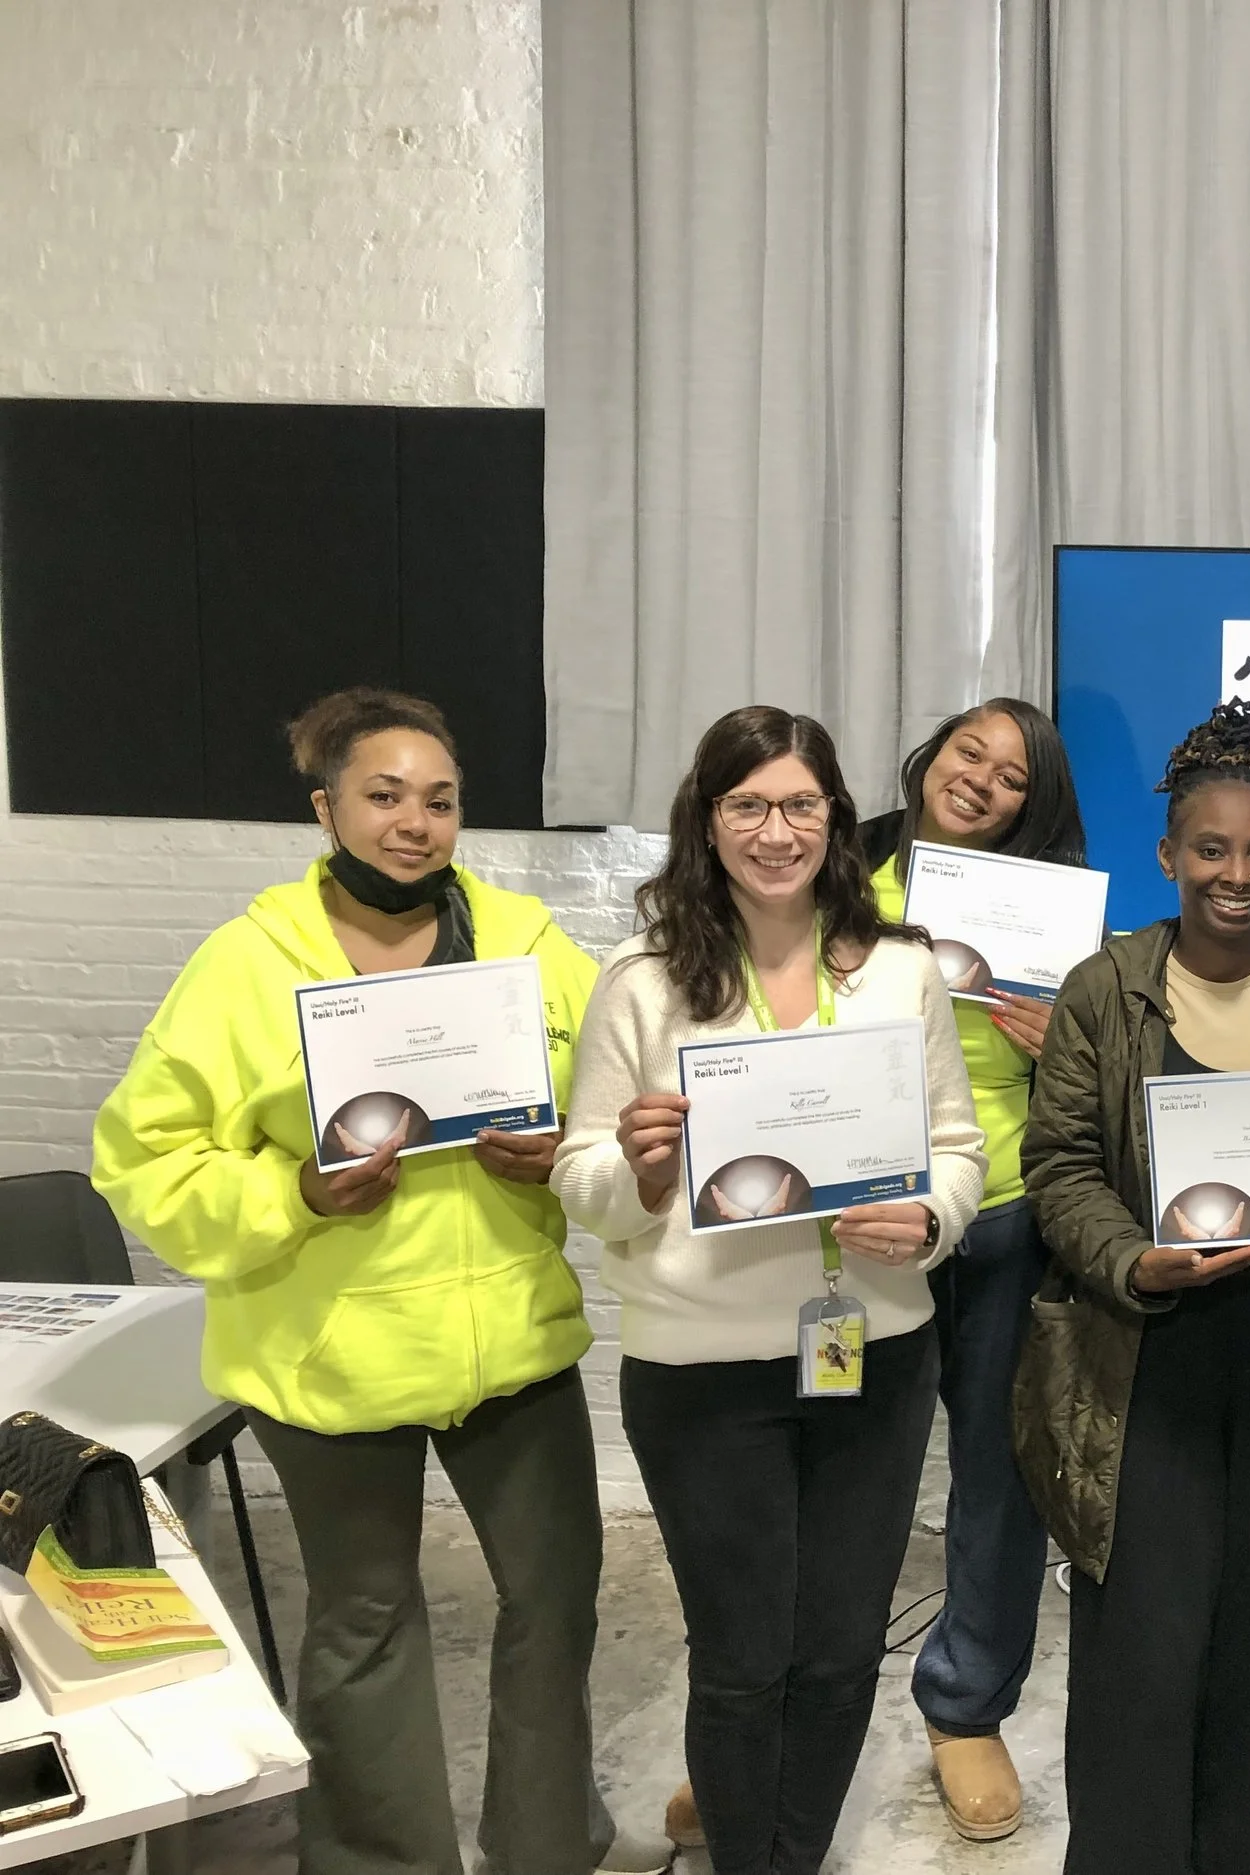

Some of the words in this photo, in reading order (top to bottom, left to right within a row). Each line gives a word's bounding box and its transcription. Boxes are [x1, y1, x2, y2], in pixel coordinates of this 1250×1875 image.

[921, 865, 939, 875] Reiki
[940, 869, 958, 878] Level
[312, 1009, 333, 1020] Reiki
[335, 1006, 358, 1017] Level
[361, 1005, 365, 1013] 1
[546, 1027, 571, 1045] LENCE
[694, 1068, 716, 1079] Reiki
[719, 1066, 742, 1076] Level
[745, 1065, 750, 1074] 1
[1160, 1102, 1178, 1111] Reiki
[1180, 1101, 1200, 1110] Level
[1203, 1101, 1207, 1109] 1
[65, 1594, 156, 1614] Reiki
